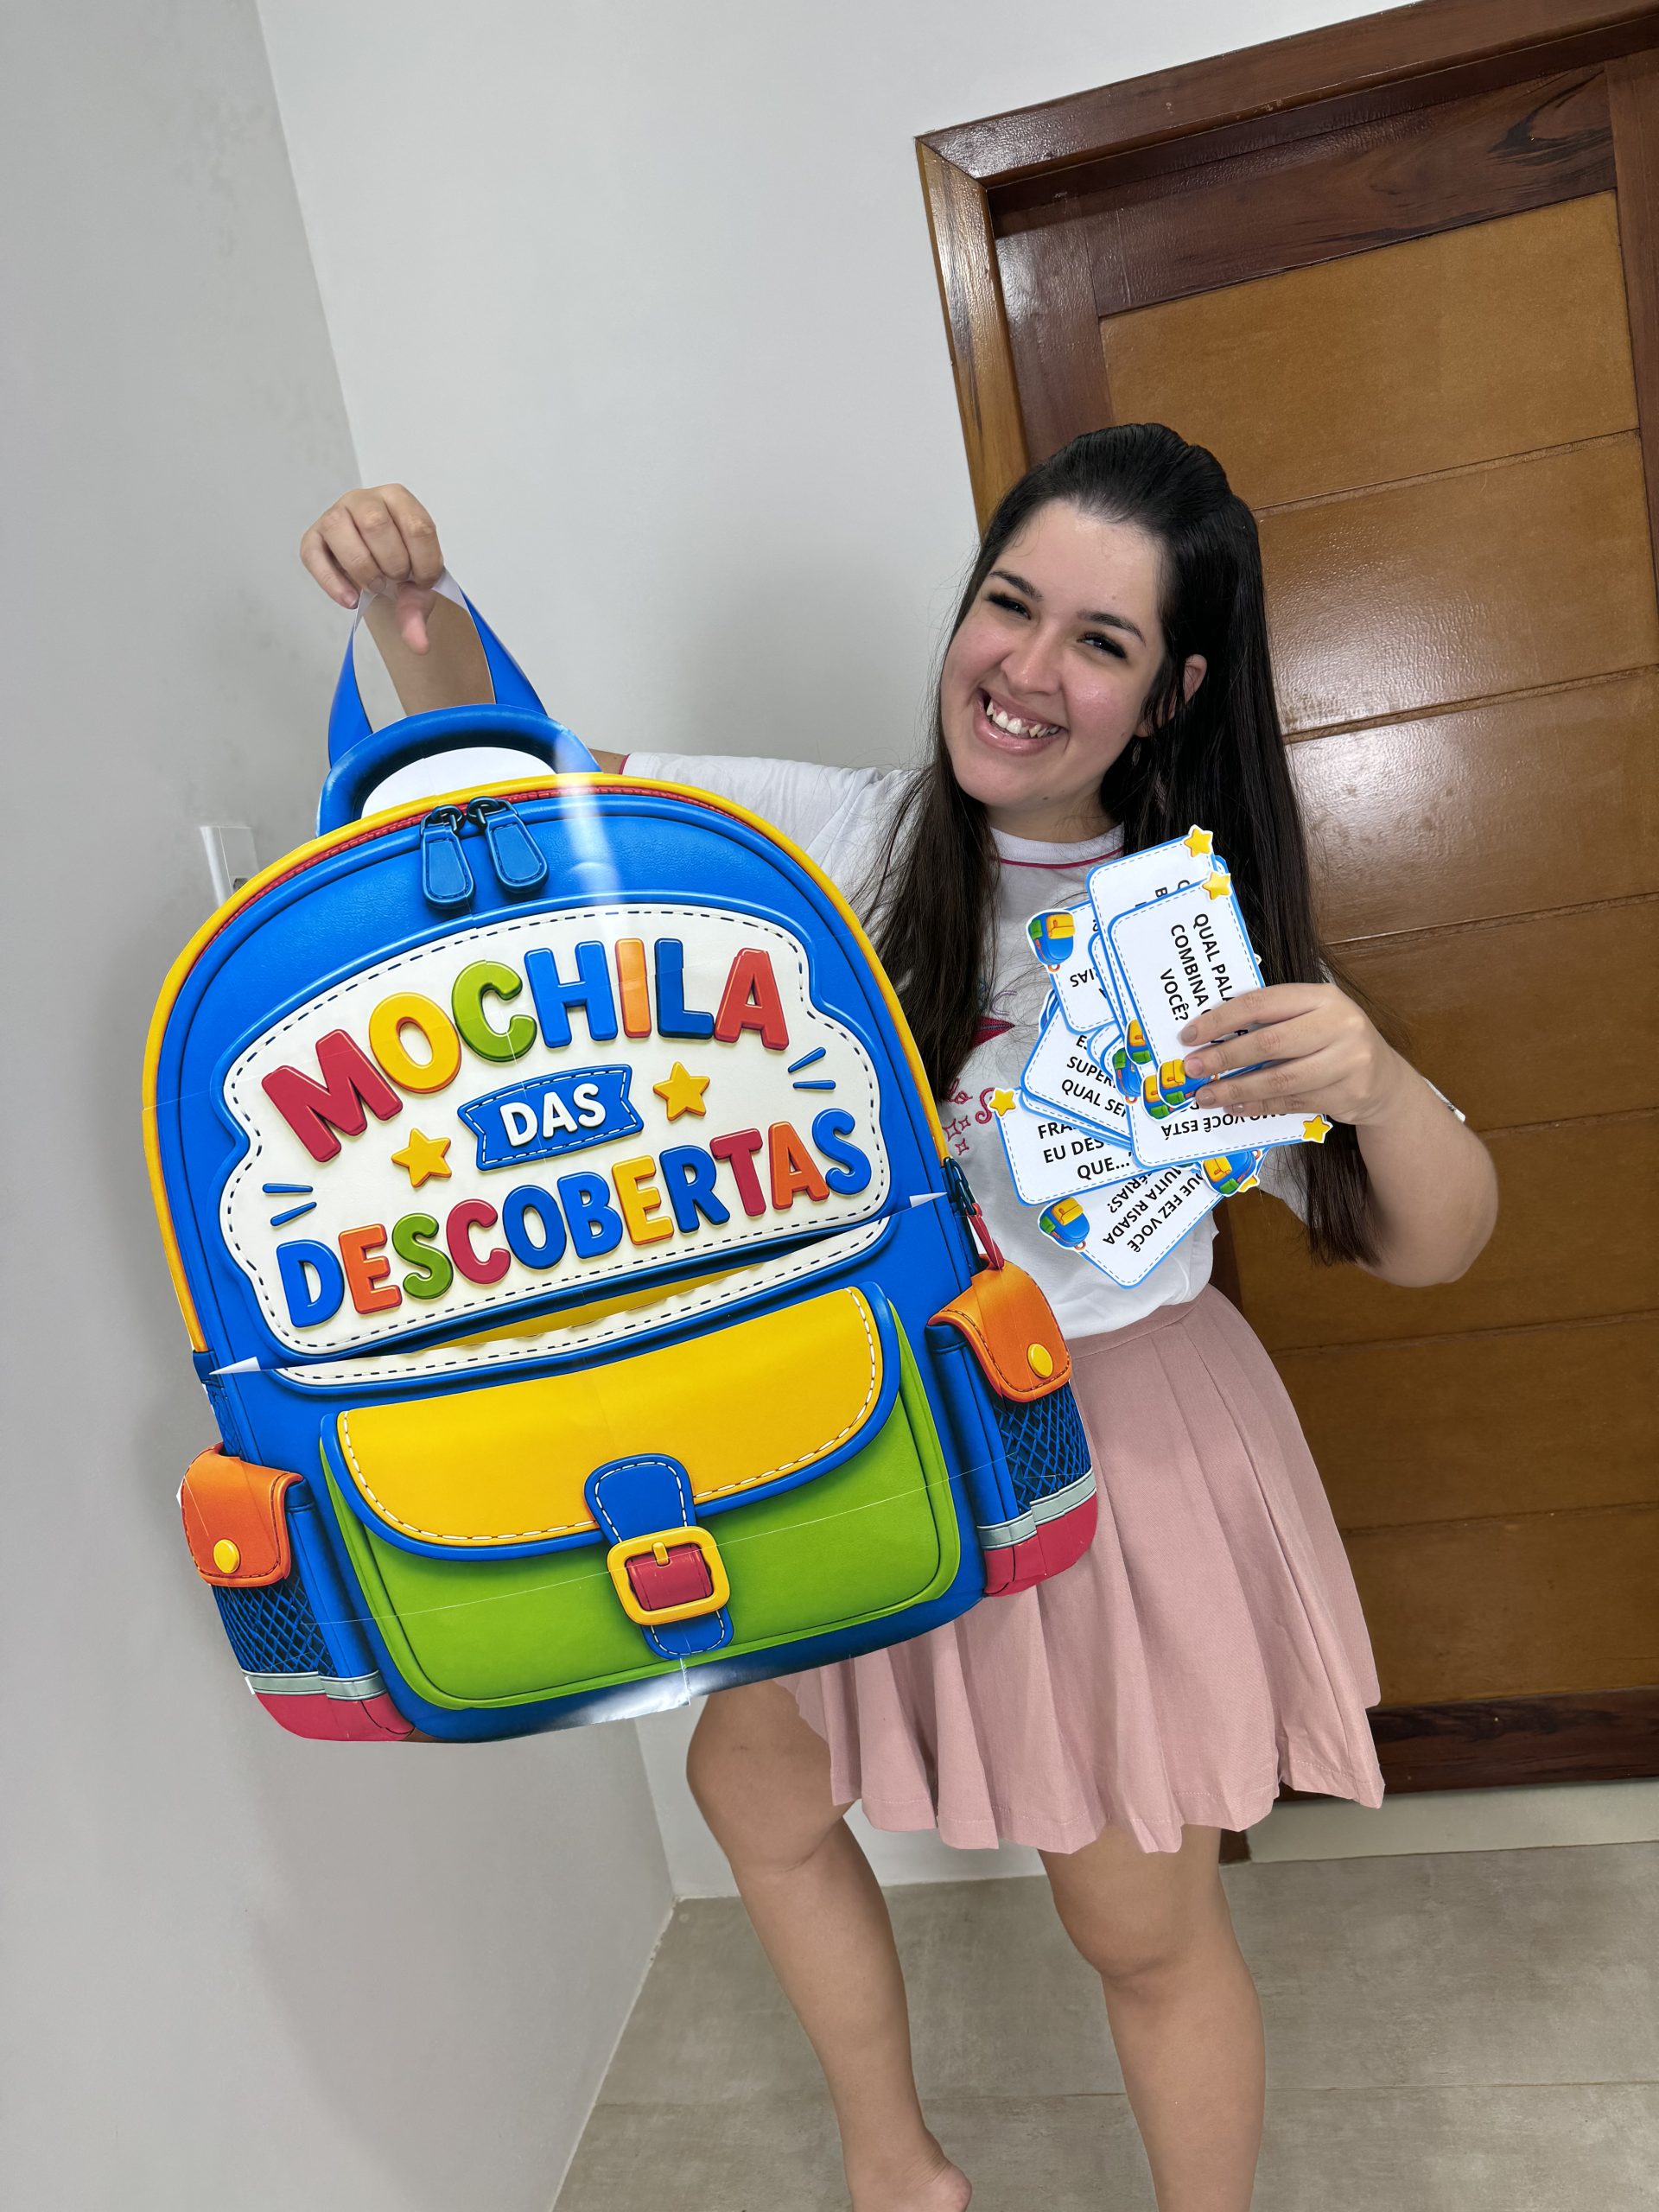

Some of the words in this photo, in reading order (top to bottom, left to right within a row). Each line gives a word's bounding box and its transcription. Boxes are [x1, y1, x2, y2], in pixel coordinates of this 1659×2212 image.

[1193, 913, 1220, 963] QUAL
[1070, 968, 1098, 987] IAS
[1171, 924, 1209, 1007] COMBINA
[1160, 968, 1189, 1020] VOCÊ?
[262, 938, 790, 1163] MOCHILA
[1061, 1079, 1102, 1107] QUAL
[500, 1083, 607, 1147] DAS
[1038, 1122, 1077, 1140] FRA
[1161, 1120, 1198, 1140] ESTÁ
[1203, 1113, 1245, 1133] VOCÊ
[1043, 1145, 1066, 1163] EU
[1071, 1137, 1110, 1156] DES
[1077, 1157, 1130, 1180] QUE...
[1107, 1173, 1152, 1214] ÉRIAS?
[1158, 1194, 1183, 1219] FEZ
[276, 1108, 872, 1329] DESCOBERTAS
[1103, 1199, 1149, 1245] RISADA
[1127, 1217, 1162, 1253] VOCÊ
